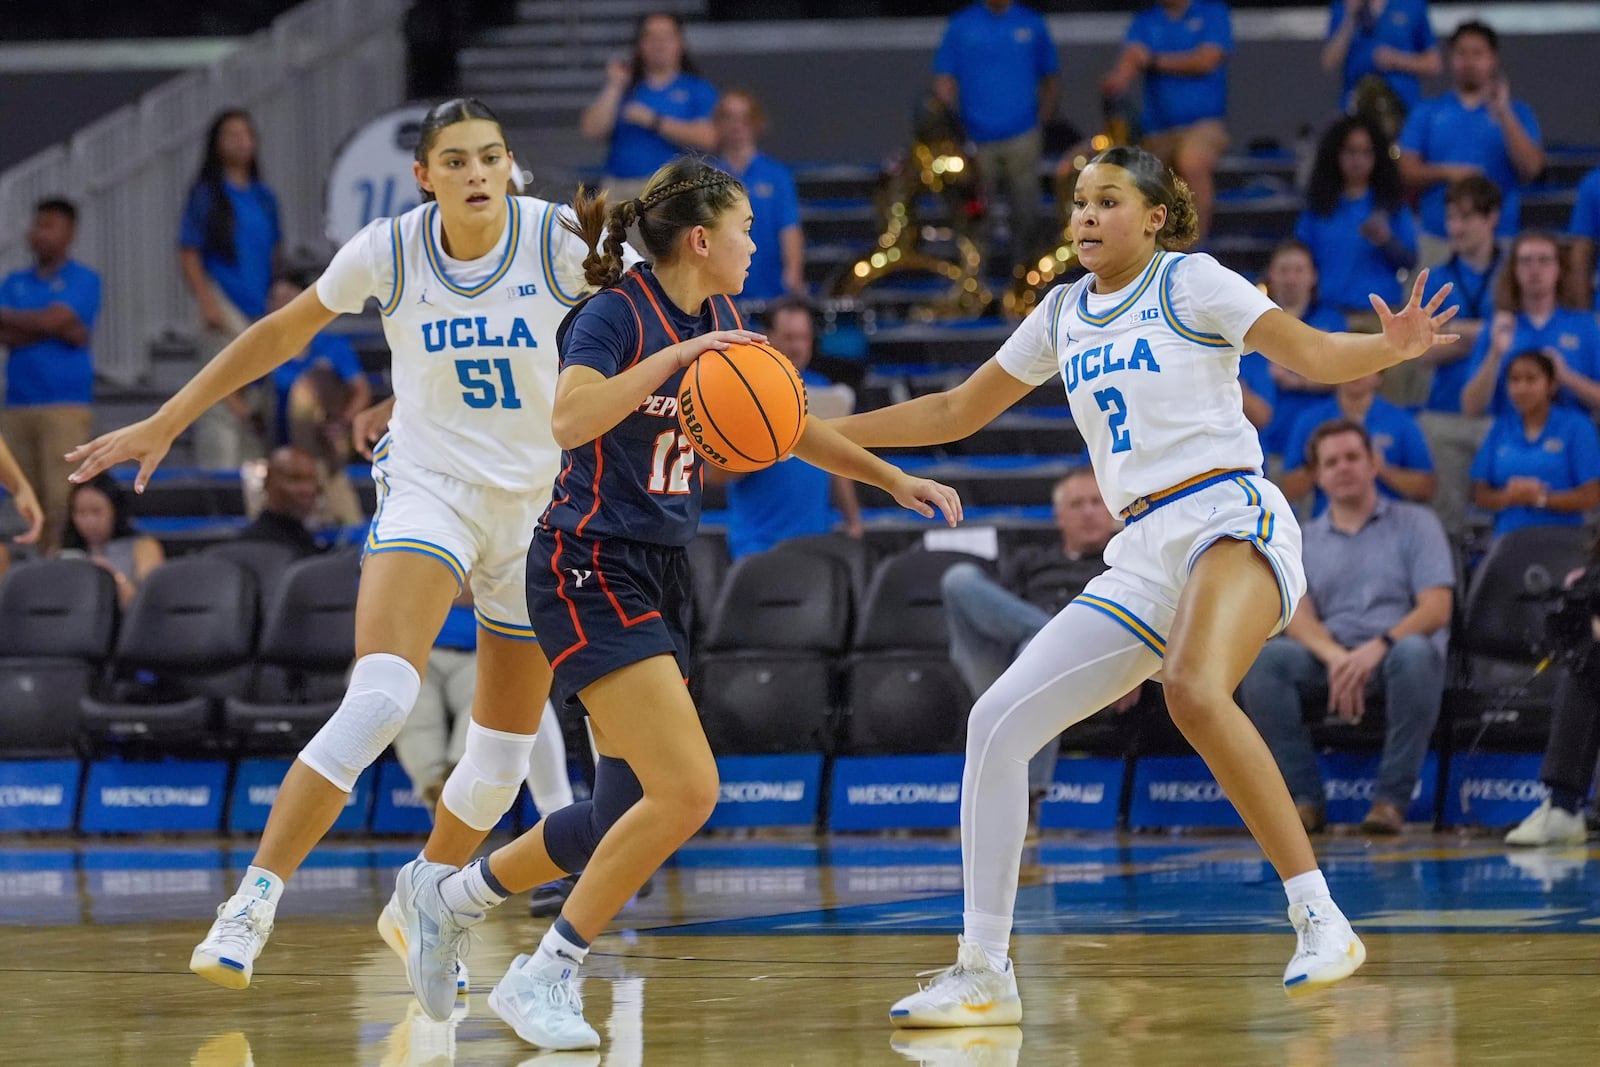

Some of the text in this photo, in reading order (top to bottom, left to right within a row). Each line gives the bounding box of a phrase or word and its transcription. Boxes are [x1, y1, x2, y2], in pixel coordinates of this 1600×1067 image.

[421, 316, 538, 353] UCLA
[454, 358, 522, 409] 51
[1065, 337, 1161, 394] UCLA
[681, 386, 729, 465] Wilson
[1093, 386, 1132, 454] 2
[647, 429, 695, 495] 12
